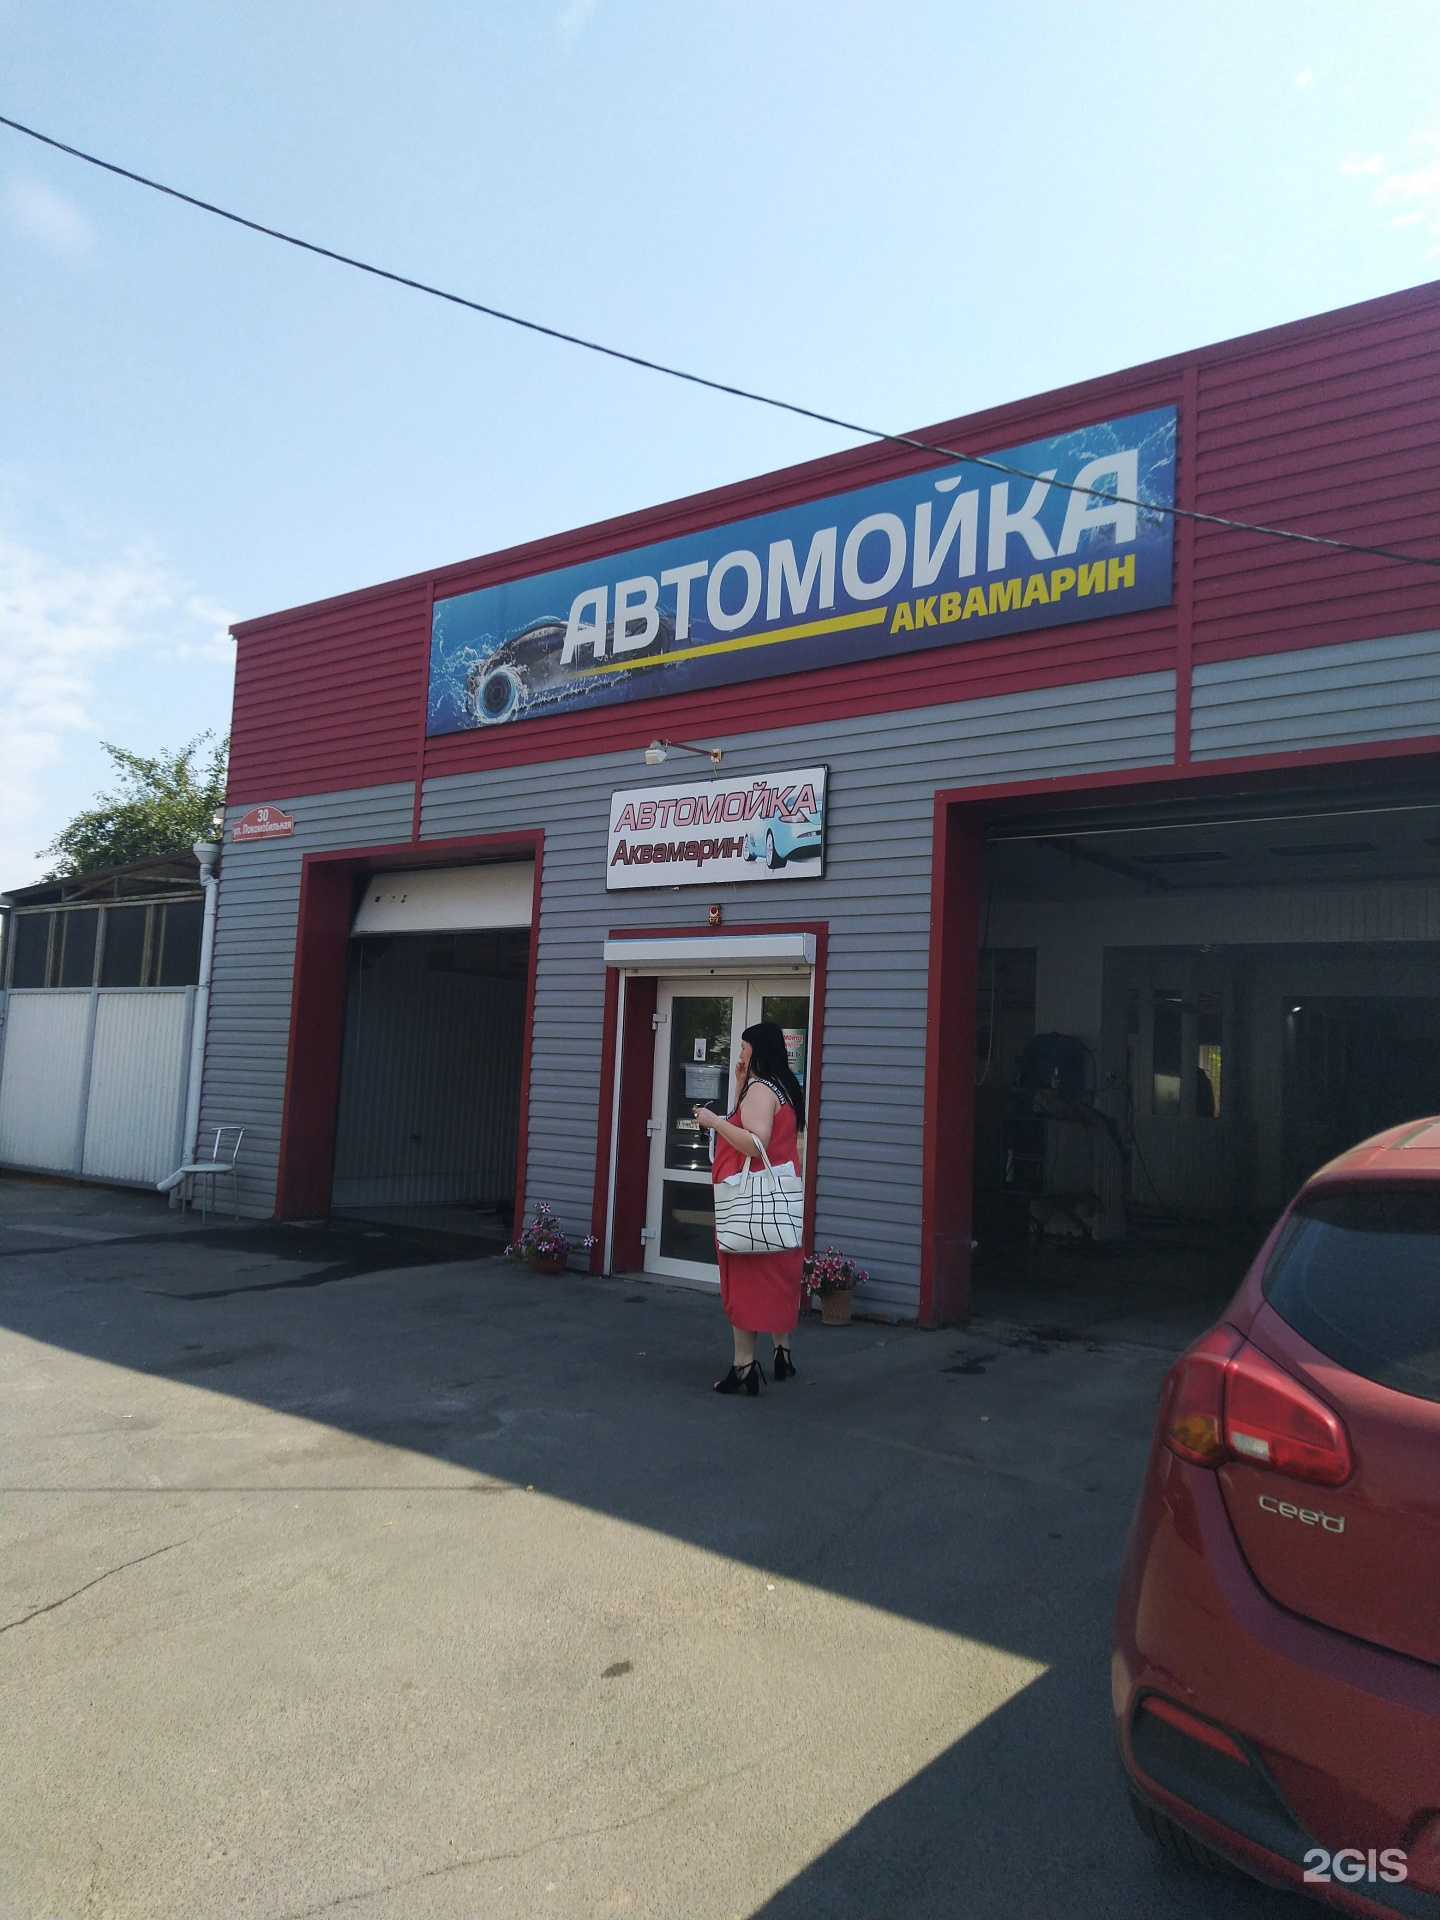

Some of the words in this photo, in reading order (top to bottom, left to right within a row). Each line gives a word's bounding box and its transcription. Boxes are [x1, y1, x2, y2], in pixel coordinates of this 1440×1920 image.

[560, 449, 1139, 665] АВТОМОЙКА
[889, 553, 1136, 634] АКВАМАРИН
[257, 808, 270, 823] 30
[614, 781, 818, 833] АВТОМОЙКА
[610, 834, 745, 867] Аквамарин
